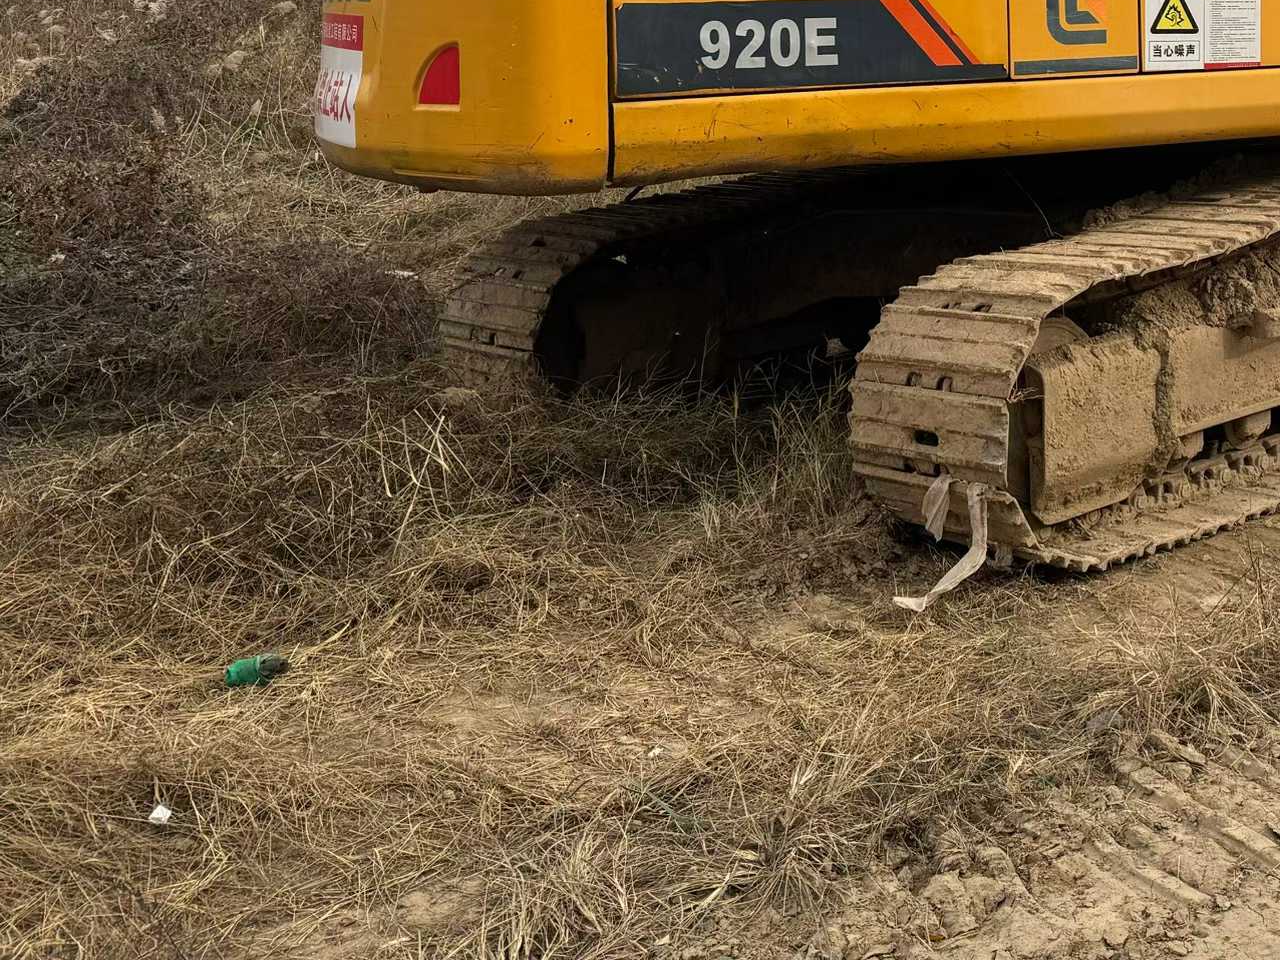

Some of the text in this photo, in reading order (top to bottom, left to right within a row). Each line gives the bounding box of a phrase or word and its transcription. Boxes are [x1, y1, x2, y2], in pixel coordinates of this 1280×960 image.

[699, 17, 840, 69] 920E
[1153, 44, 1196, 58] 当心噪声
